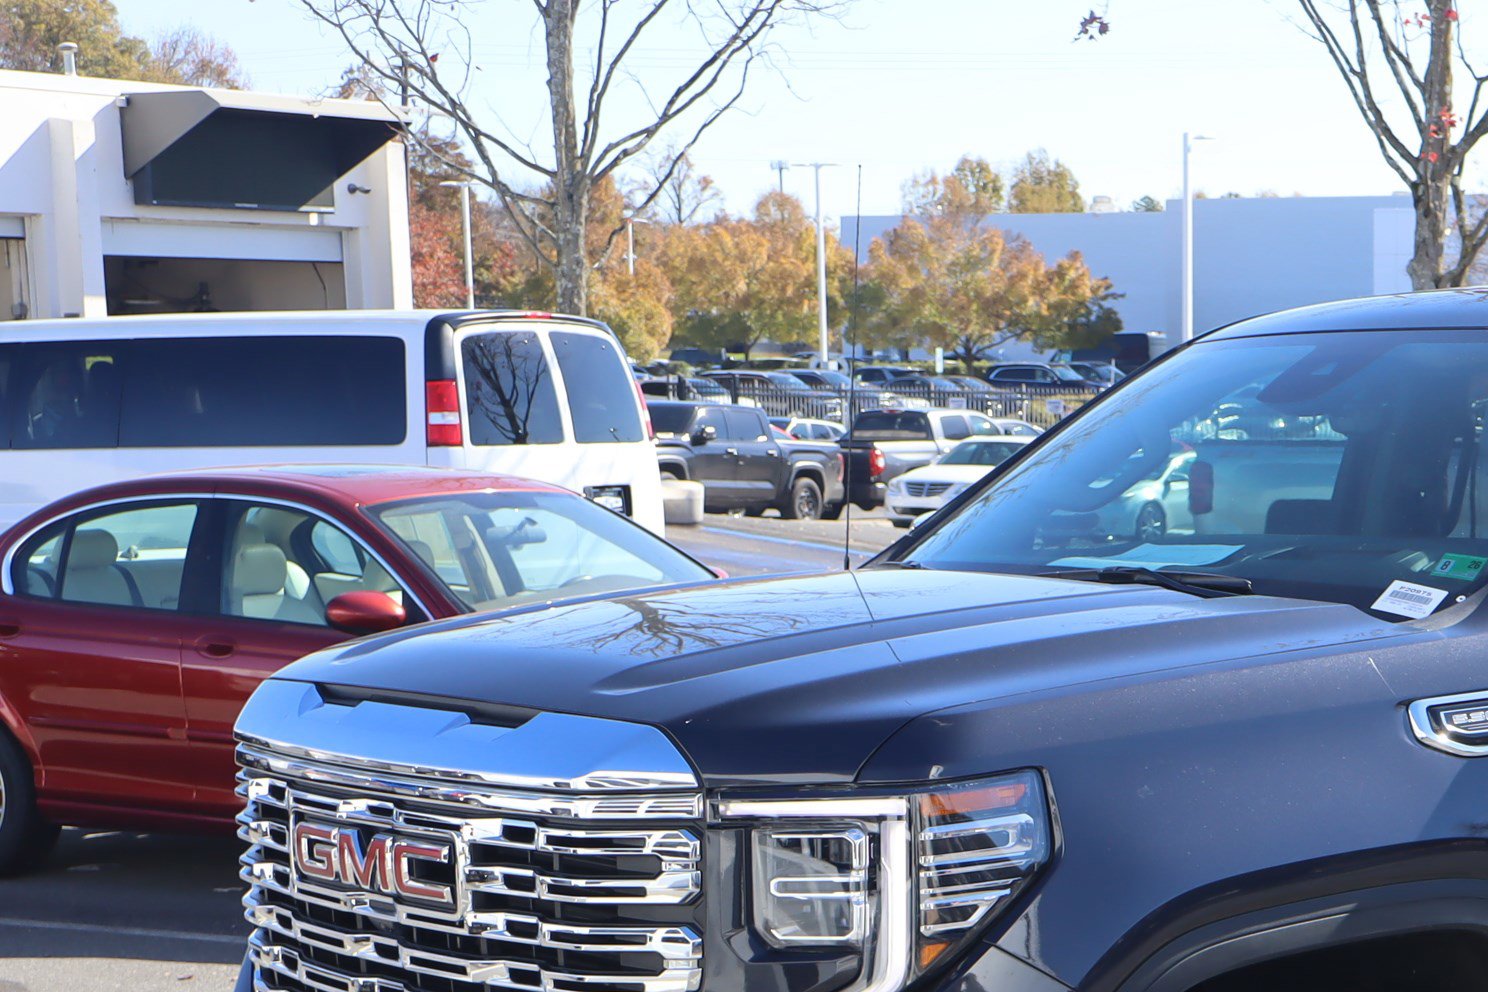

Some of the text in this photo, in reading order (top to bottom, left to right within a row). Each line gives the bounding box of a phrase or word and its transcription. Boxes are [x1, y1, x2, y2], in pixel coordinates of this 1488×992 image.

[1440, 560, 1452, 571] 8
[1467, 560, 1482, 570] 26
[295, 822, 453, 904] GMC
